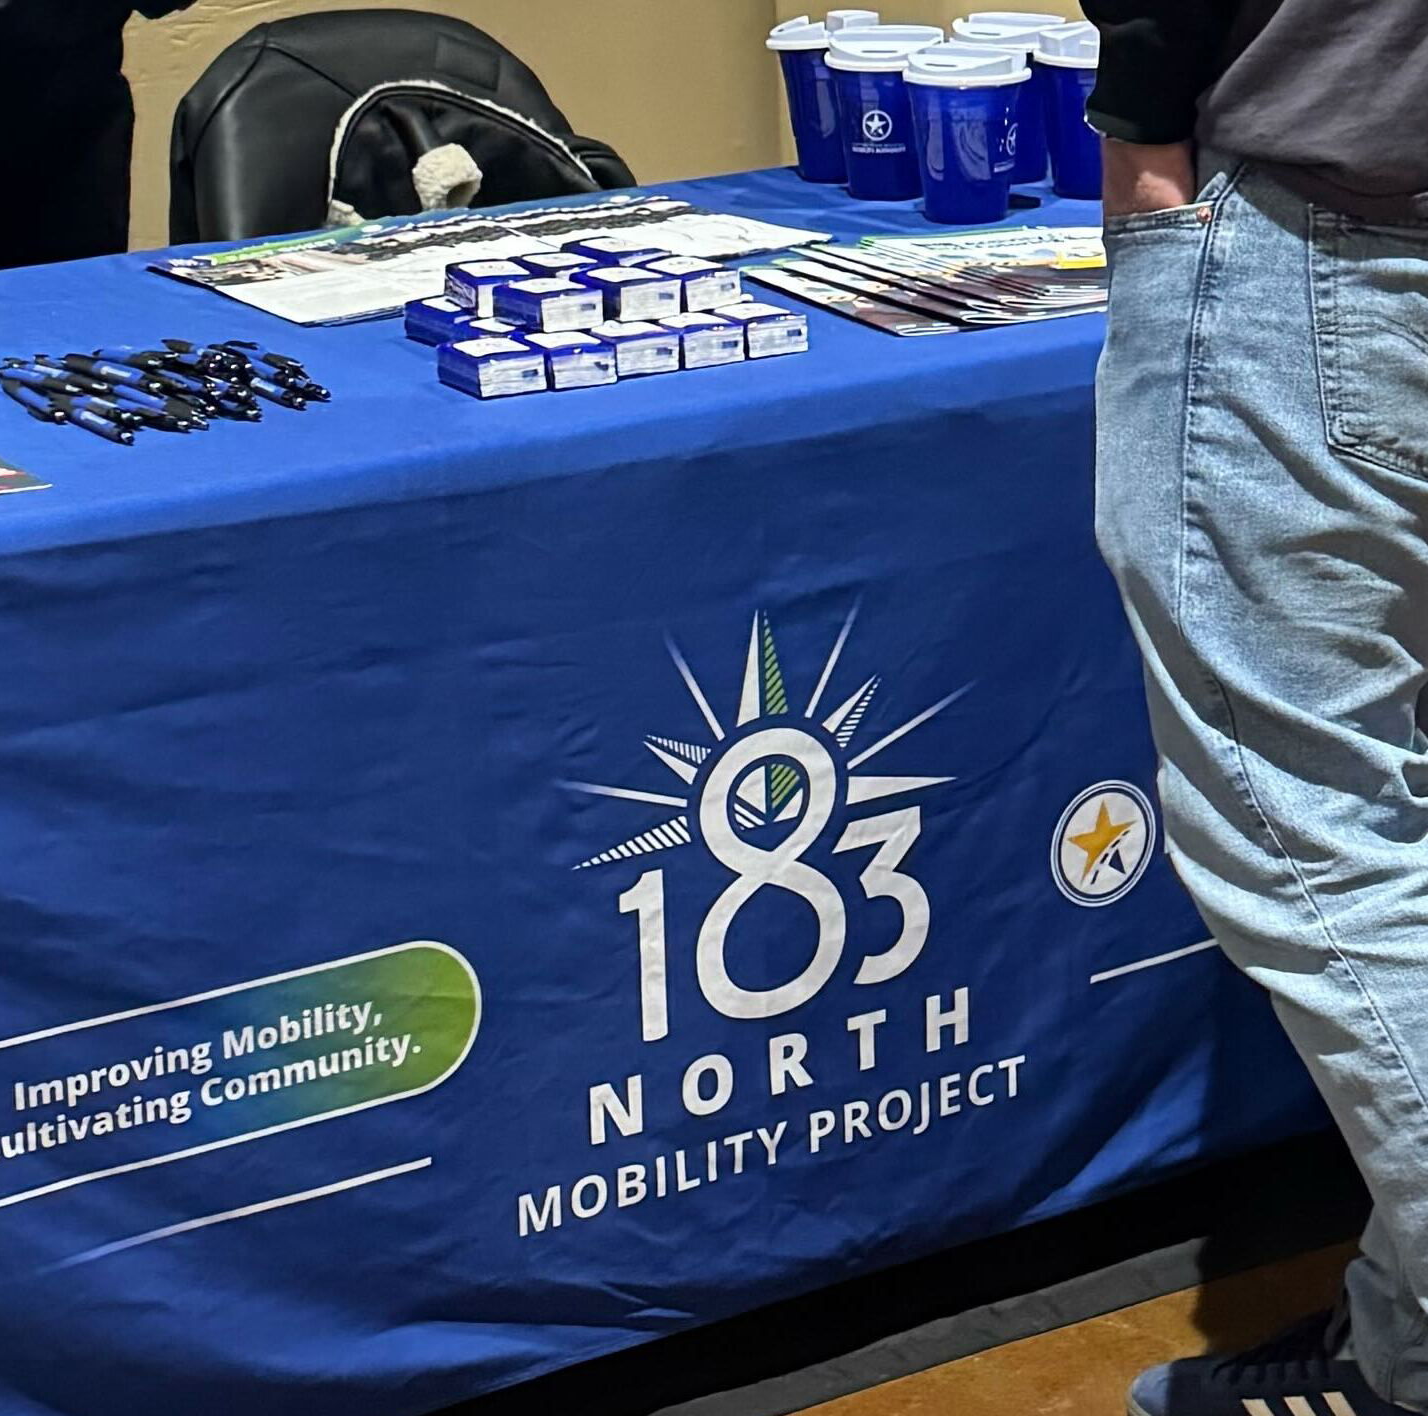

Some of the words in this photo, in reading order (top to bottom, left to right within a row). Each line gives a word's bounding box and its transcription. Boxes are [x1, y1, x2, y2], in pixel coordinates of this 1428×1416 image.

[619, 728, 931, 1042] 183
[14, 1038, 213, 1112] Improving
[221, 1000, 383, 1061] Mobility,
[201, 1028, 423, 1108] Community.
[589, 986, 970, 1145] NORTH
[517, 1121, 787, 1238] MOBILITY
[810, 1055, 1025, 1154] PROJECT
